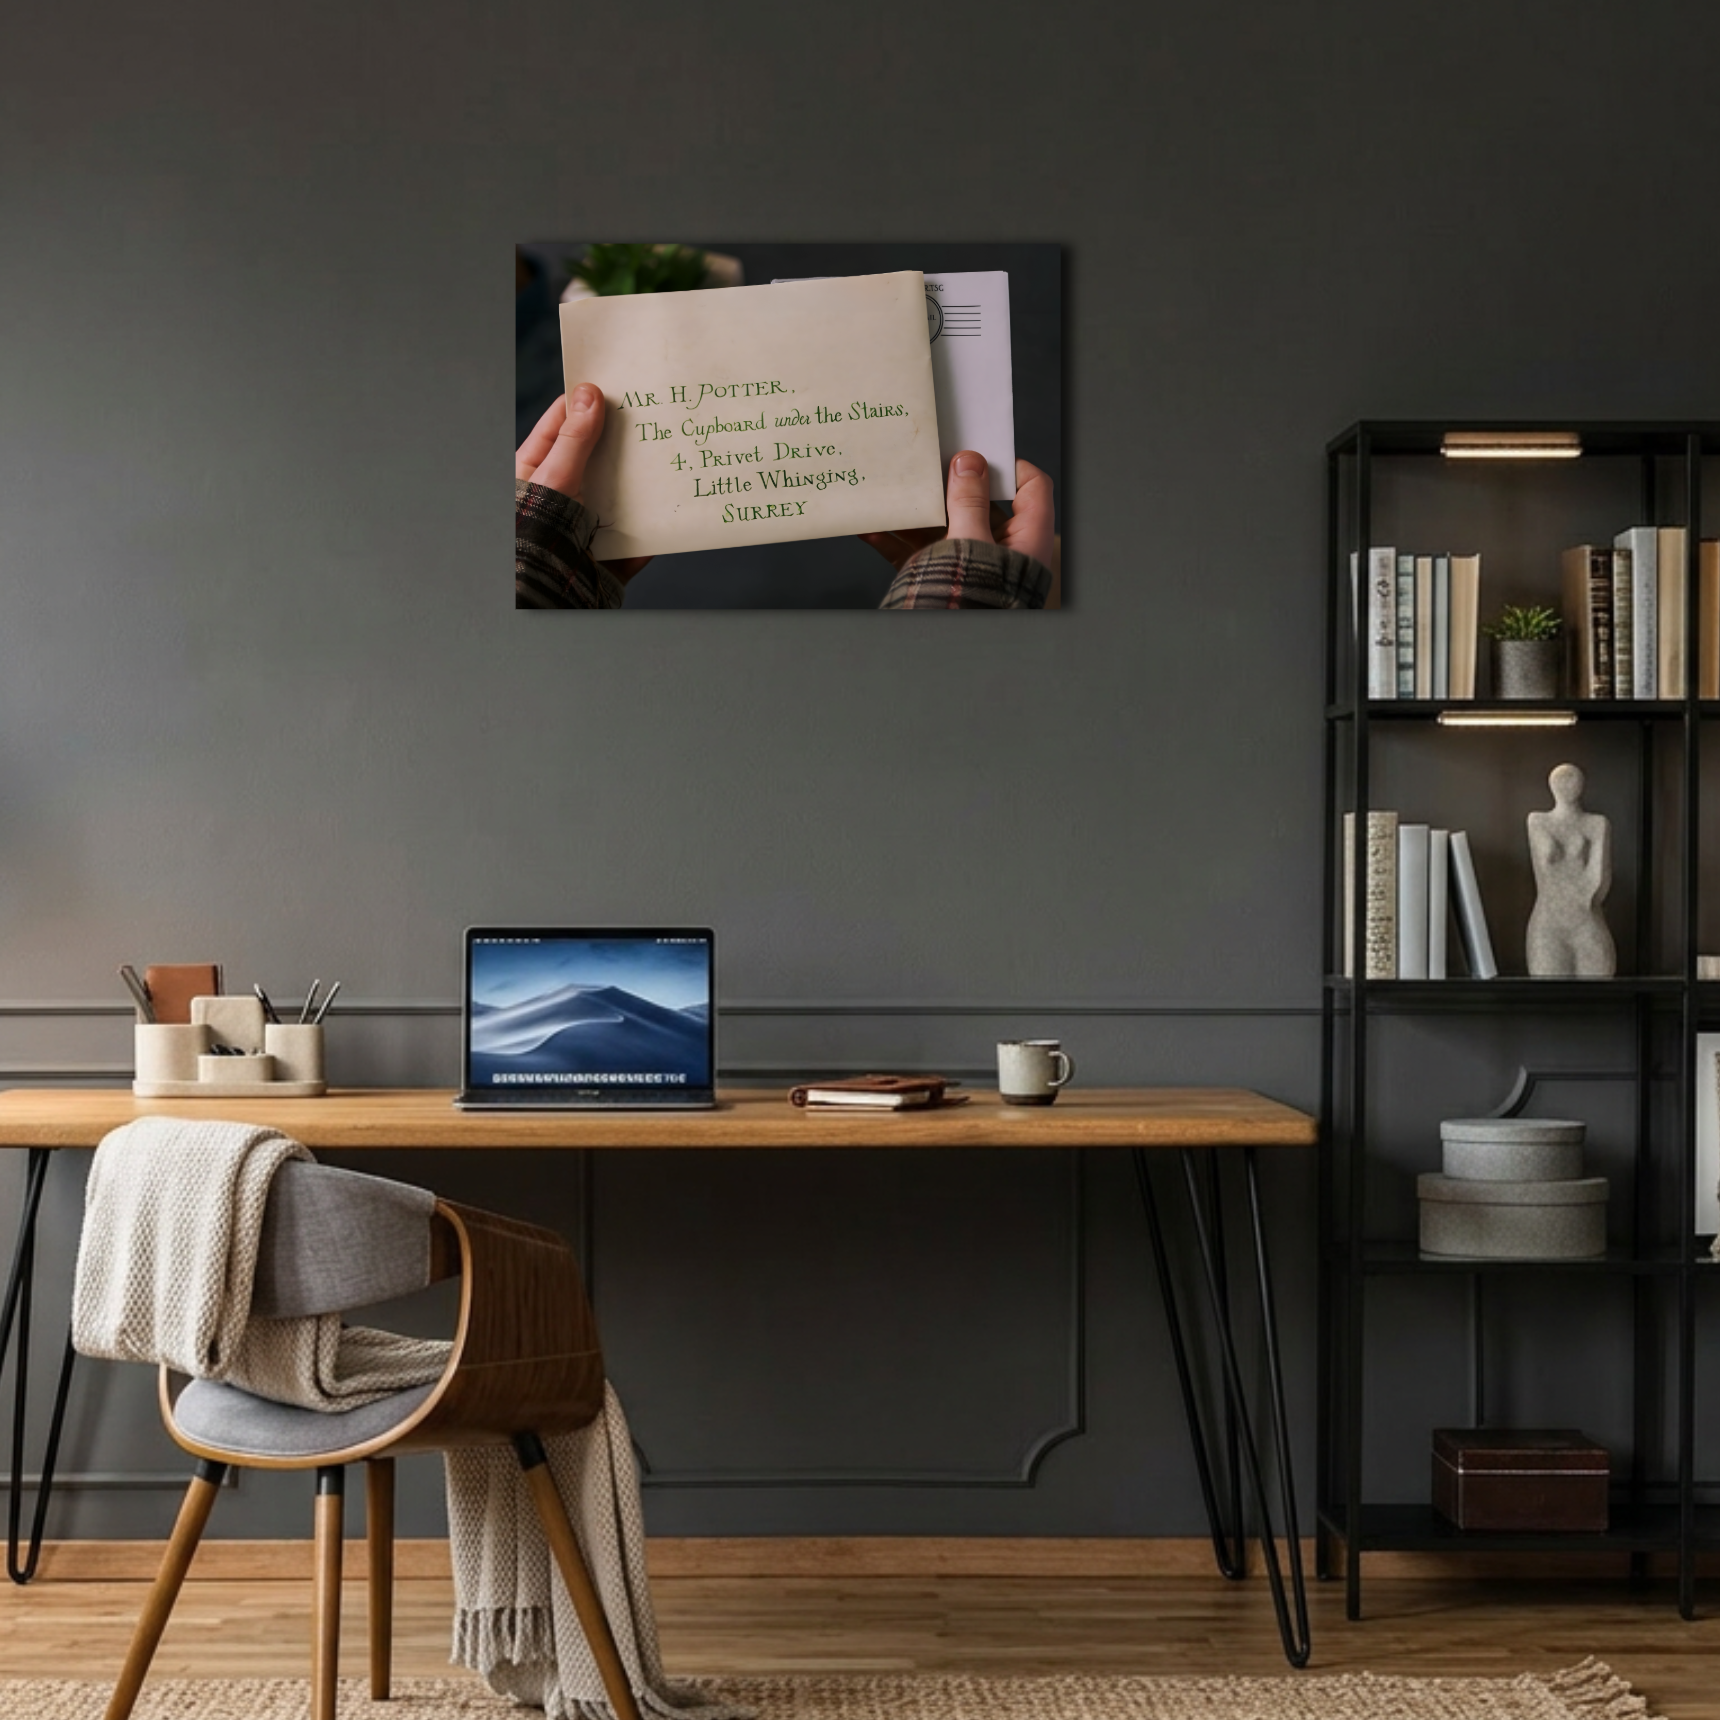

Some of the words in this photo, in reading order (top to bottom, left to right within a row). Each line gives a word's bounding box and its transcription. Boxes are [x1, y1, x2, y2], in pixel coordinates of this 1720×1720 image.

[669, 385, 692, 404] H.
[685, 380, 796, 411] POTTER,
[634, 421, 673, 442] The
[774, 408, 812, 428] under
[814, 405, 843, 425] the
[669, 452, 694, 472] 4,
[693, 476, 753, 498] Little
[721, 500, 808, 524] SURREY
